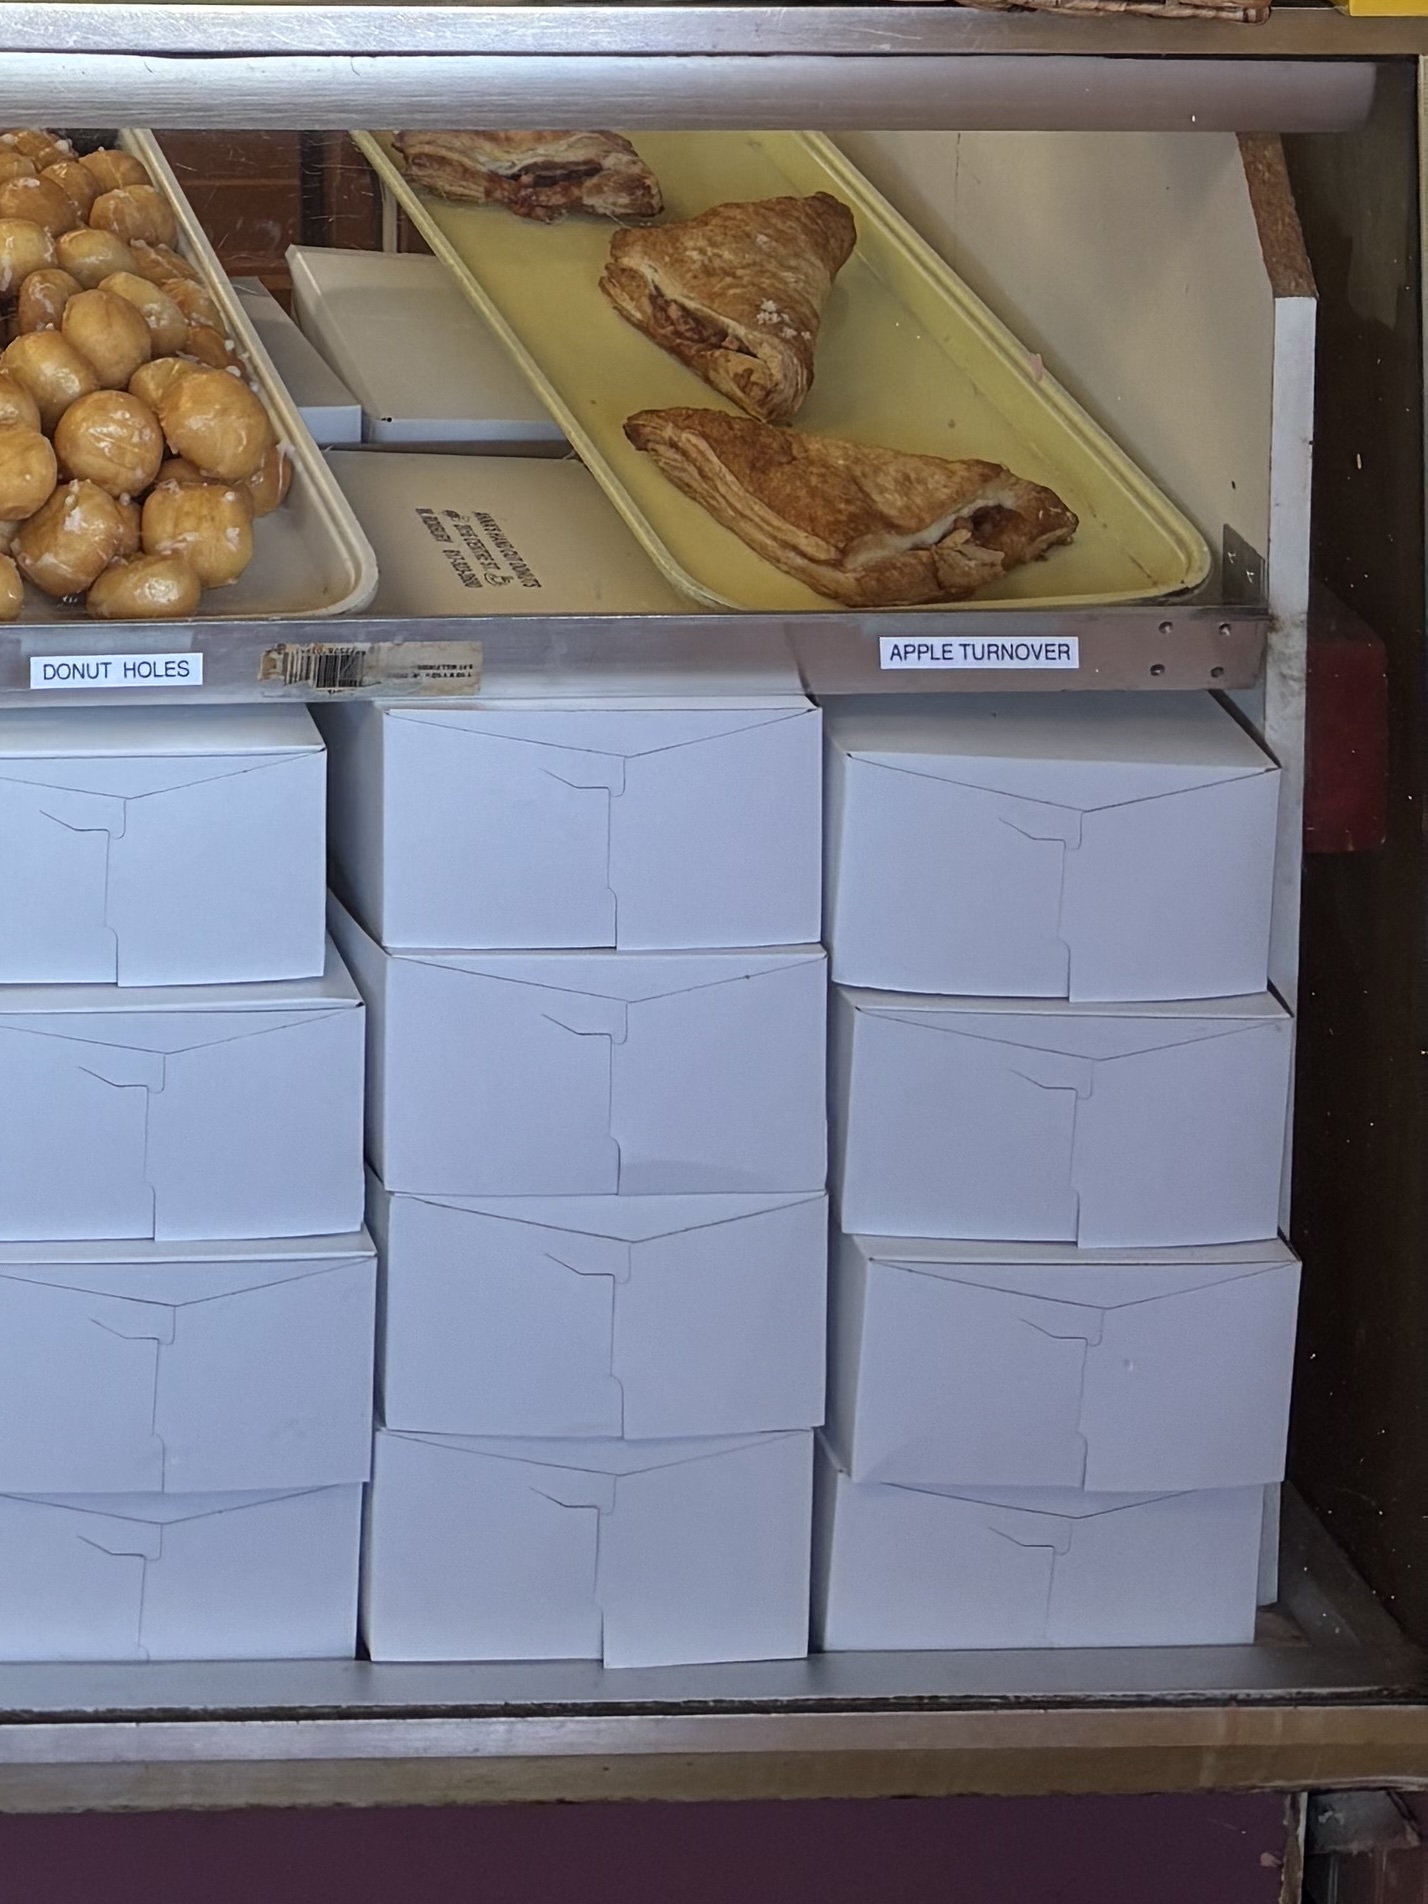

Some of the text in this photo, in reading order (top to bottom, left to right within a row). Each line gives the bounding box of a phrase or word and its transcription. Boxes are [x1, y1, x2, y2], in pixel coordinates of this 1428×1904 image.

[890, 642, 1071, 662] APPLE TURNOVER
[43, 660, 190, 682] DONUT HOLES
